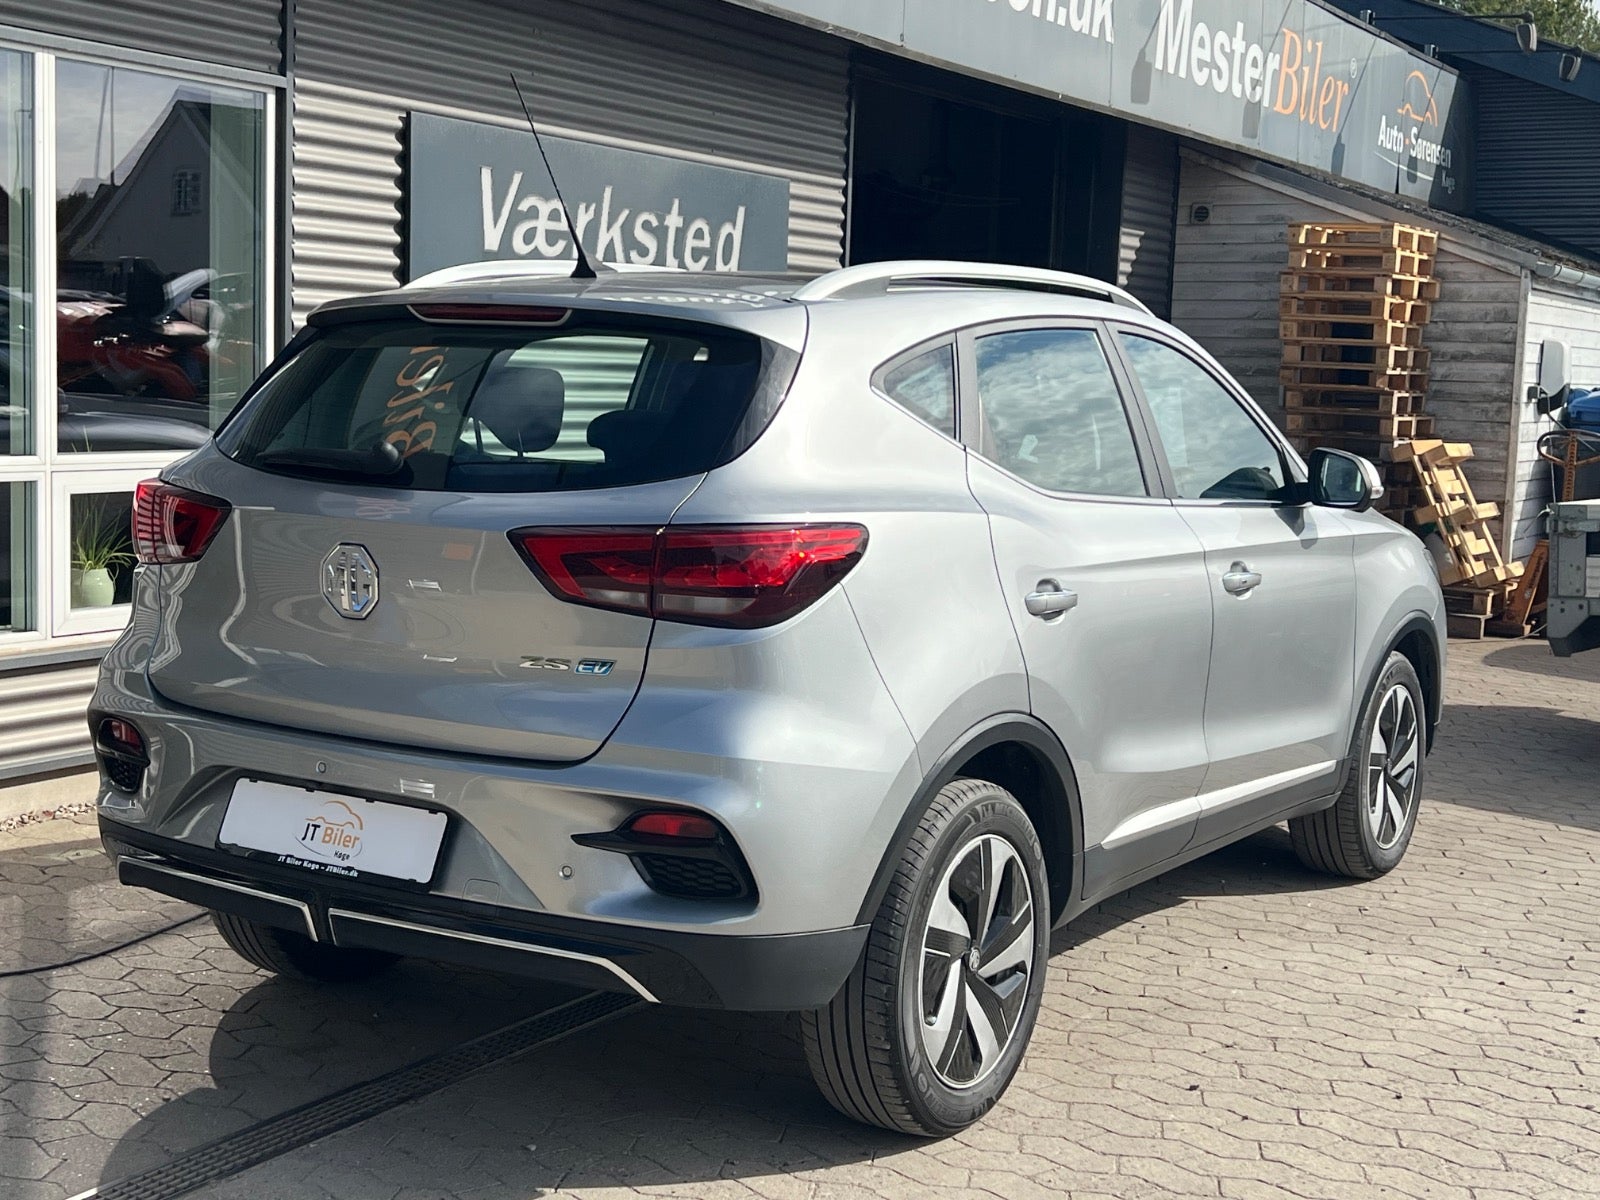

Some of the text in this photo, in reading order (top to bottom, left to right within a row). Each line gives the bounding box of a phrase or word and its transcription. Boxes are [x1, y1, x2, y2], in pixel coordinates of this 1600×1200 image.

[1378, 114, 1404, 153] Auto
[480, 166, 747, 272] Værksted
[328, 551, 373, 612] MG
[519, 655, 614, 674] ZS EV
[301, 823, 360, 849] JT Biler
[285, 857, 302, 866] Biler
